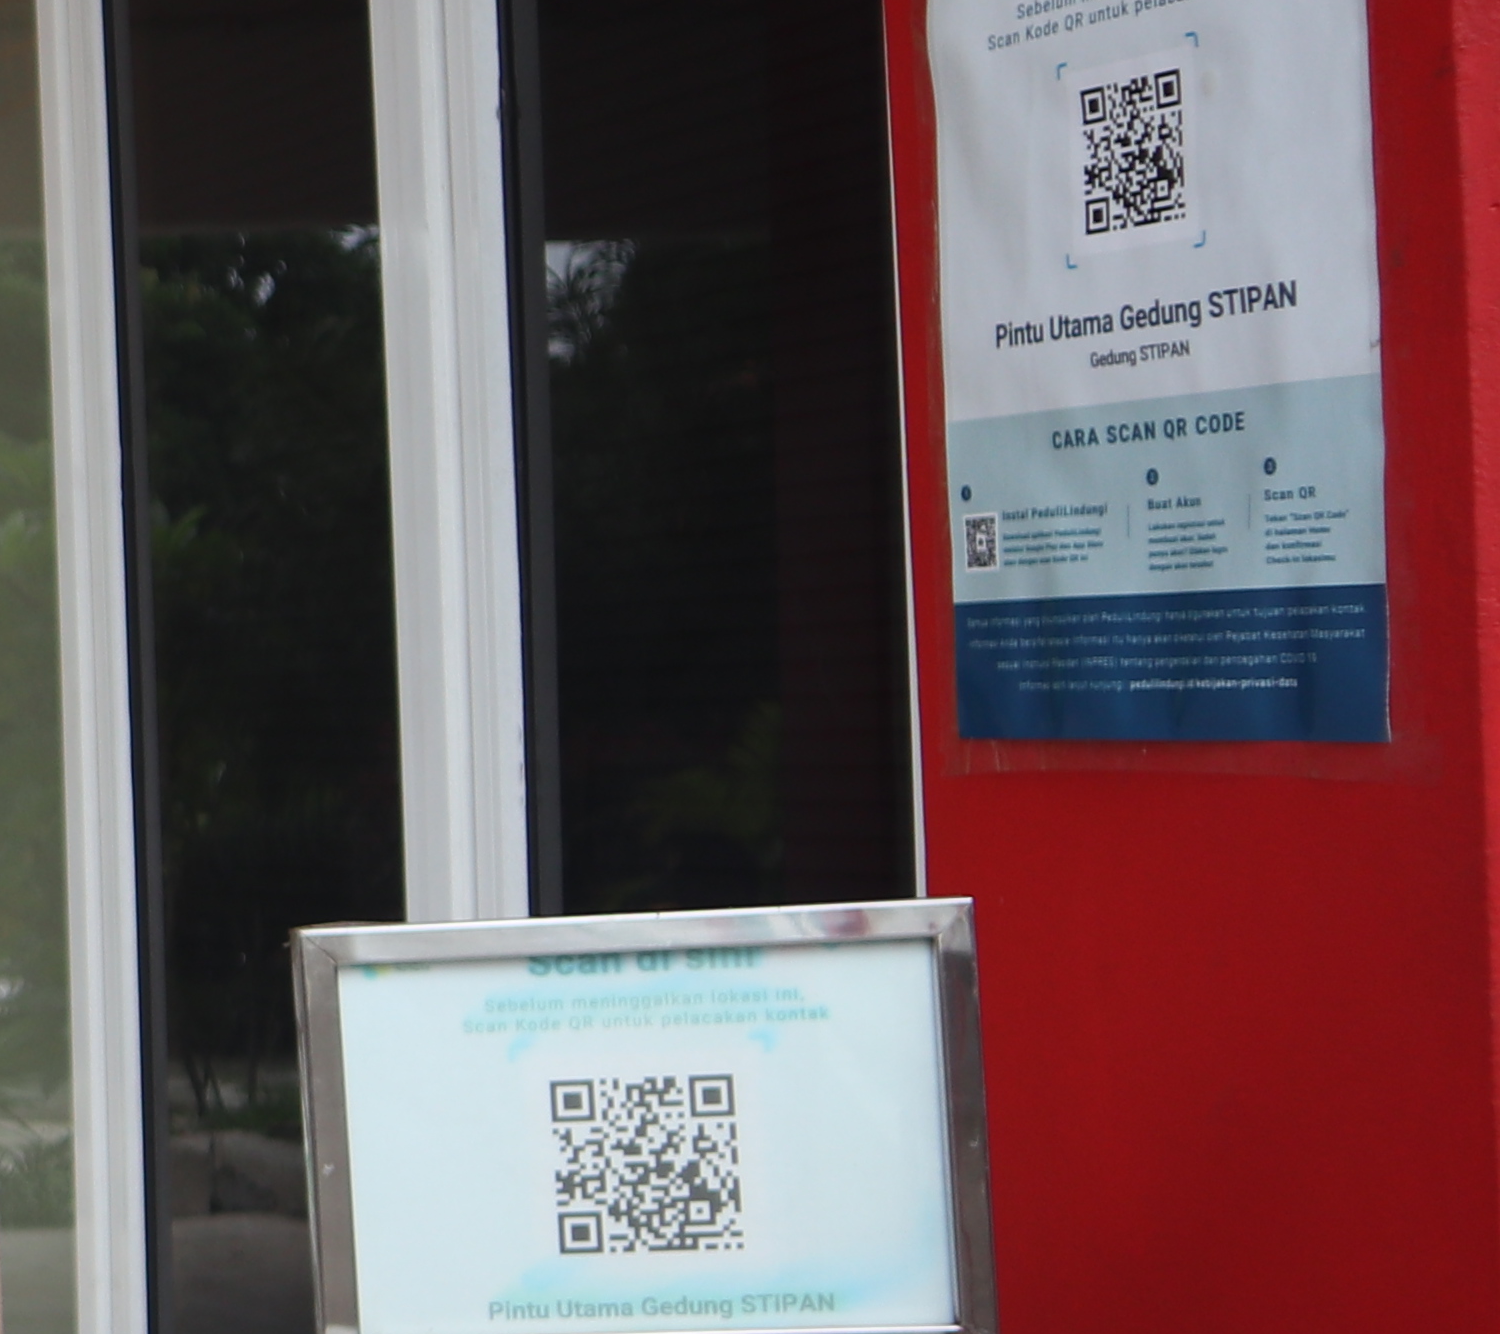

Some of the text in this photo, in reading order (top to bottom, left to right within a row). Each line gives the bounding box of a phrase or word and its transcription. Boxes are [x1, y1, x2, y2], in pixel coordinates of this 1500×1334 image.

[987, 31, 1021, 51] Scan
[1026, 20, 1059, 42] Kode
[1064, 11, 1084, 30] QR
[1088, 3, 1129, 25] untuk
[995, 280, 1297, 349] Pintu Utama Gedung STIPAN
[1090, 340, 1190, 368] Gedung STIPAN
[1052, 411, 1245, 450] CARA SCAN QR CODE
[1148, 496, 1202, 510] Buat Akun
[1264, 486, 1316, 501] Scan QR
[527, 952, 621, 976] Scan
[484, 996, 563, 1014] Sebelum
[571, 990, 703, 1012] meninggalkan
[710, 988, 768, 1004] lokasi
[462, 1004, 831, 1035] Scan Kode QR untuk pelacakan kontak
[488, 1291, 836, 1322] Pintu Utama Gedung STIPAN
